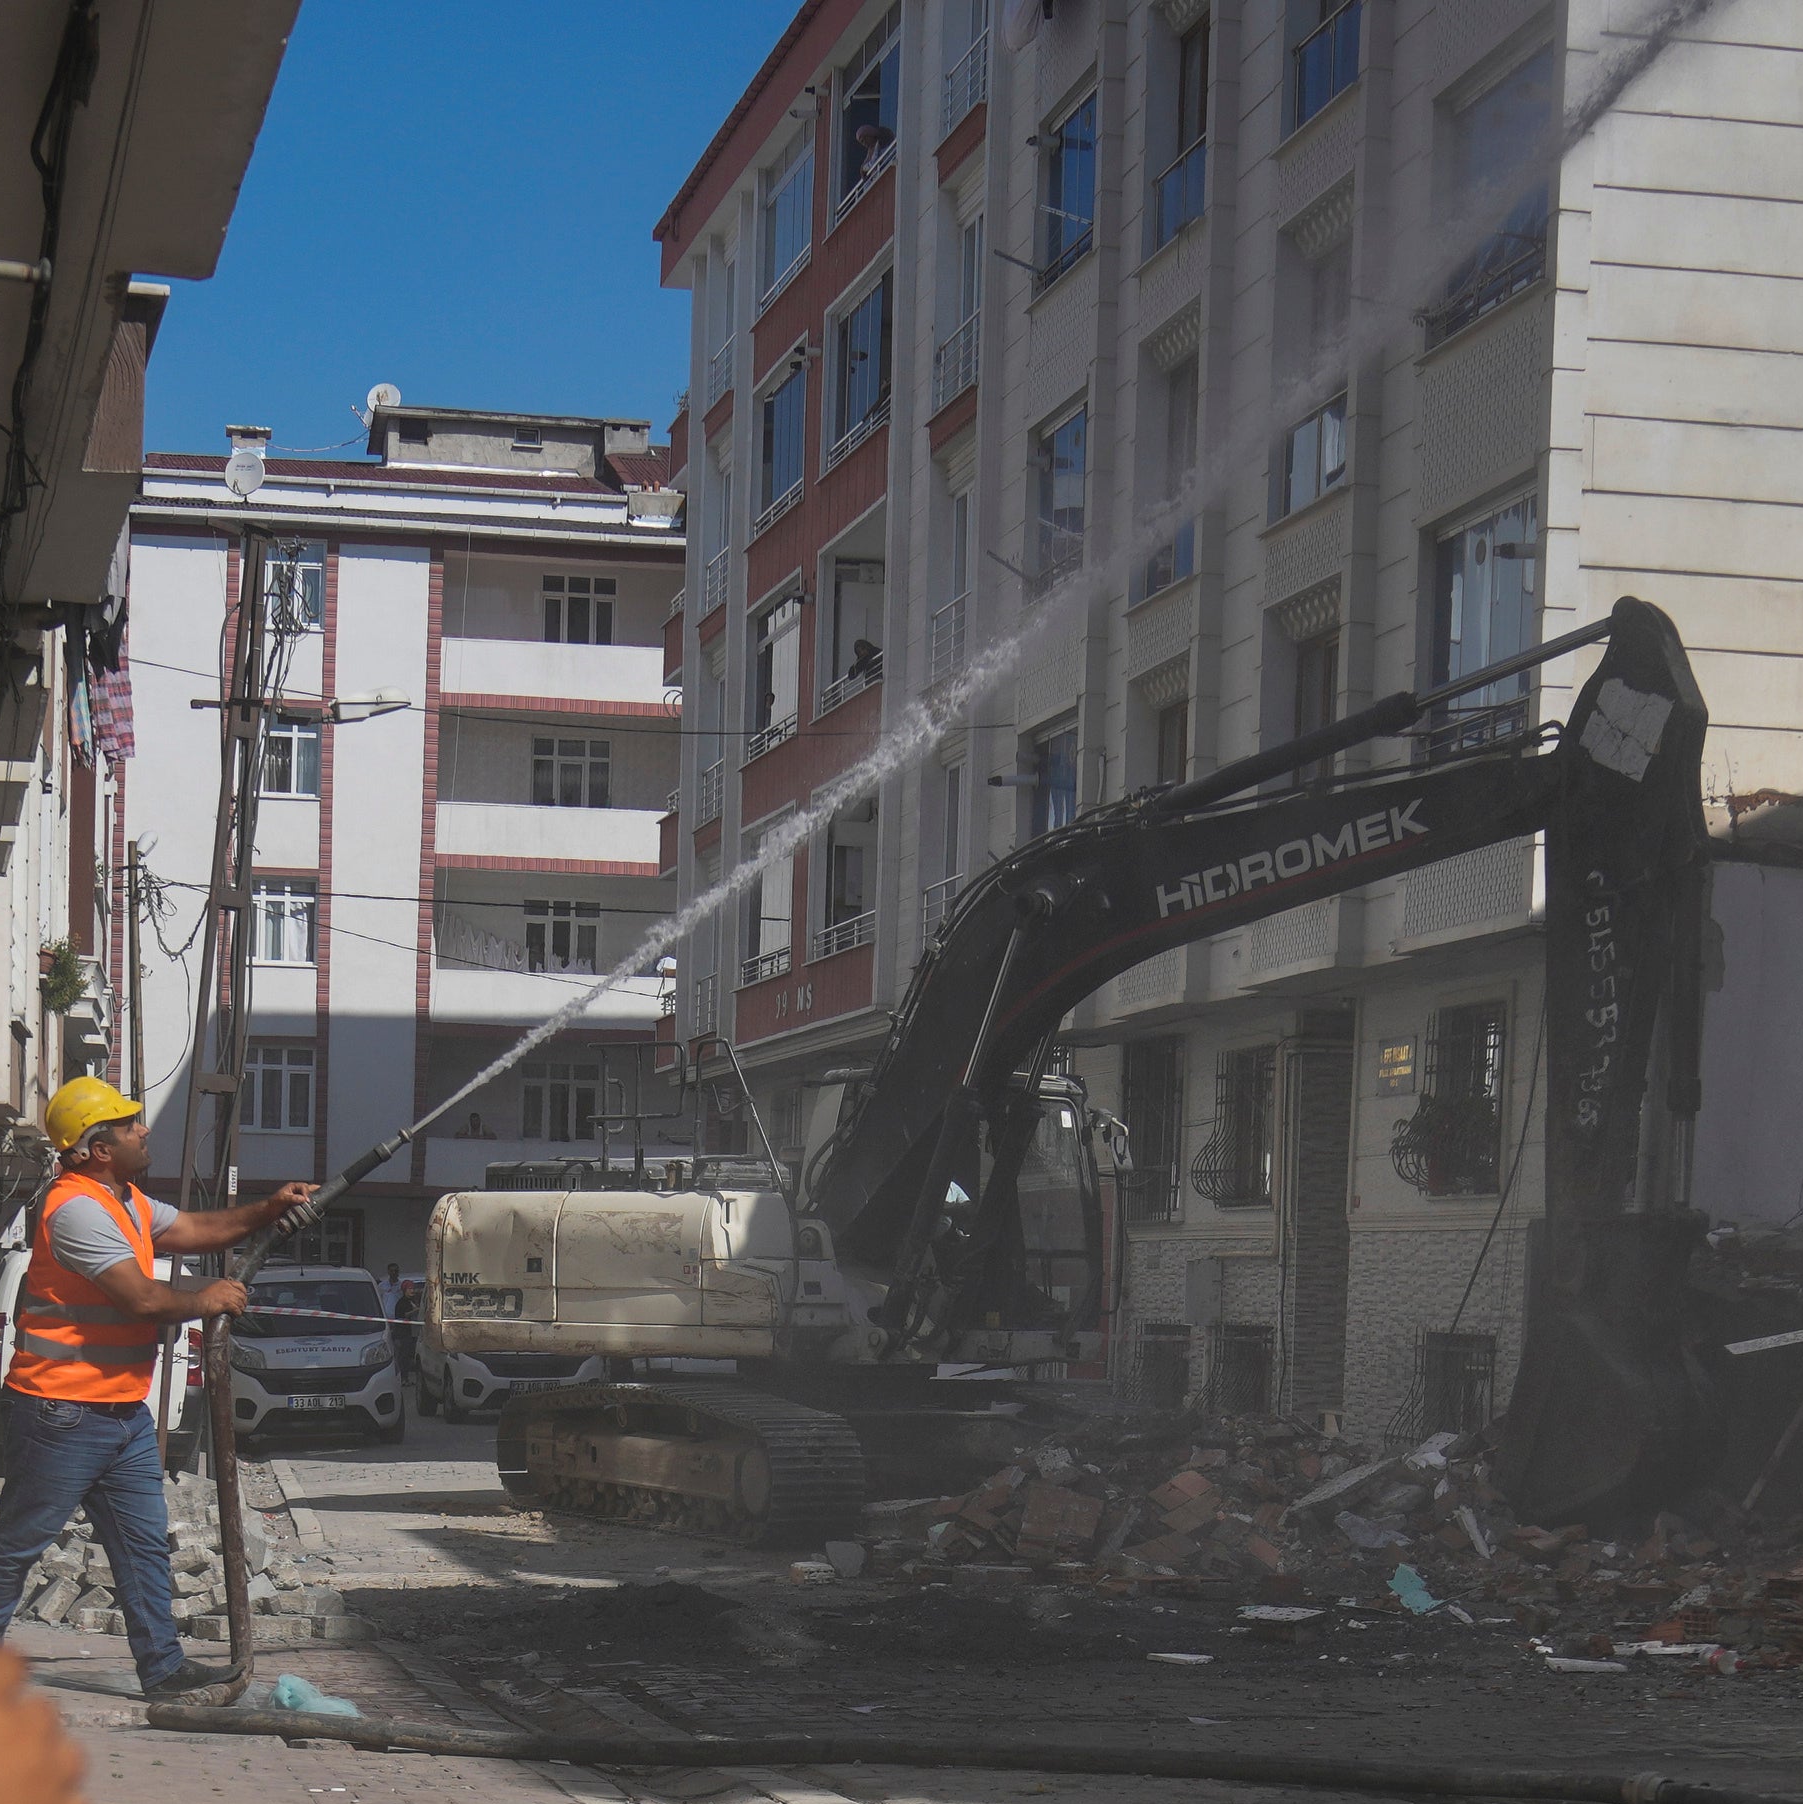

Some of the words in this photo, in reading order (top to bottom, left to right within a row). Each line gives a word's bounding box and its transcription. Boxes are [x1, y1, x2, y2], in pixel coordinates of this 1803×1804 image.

[443, 1272, 481, 1284] HMK
[294, 1398, 305, 1408] 33
[329, 1397, 344, 1407] 213
